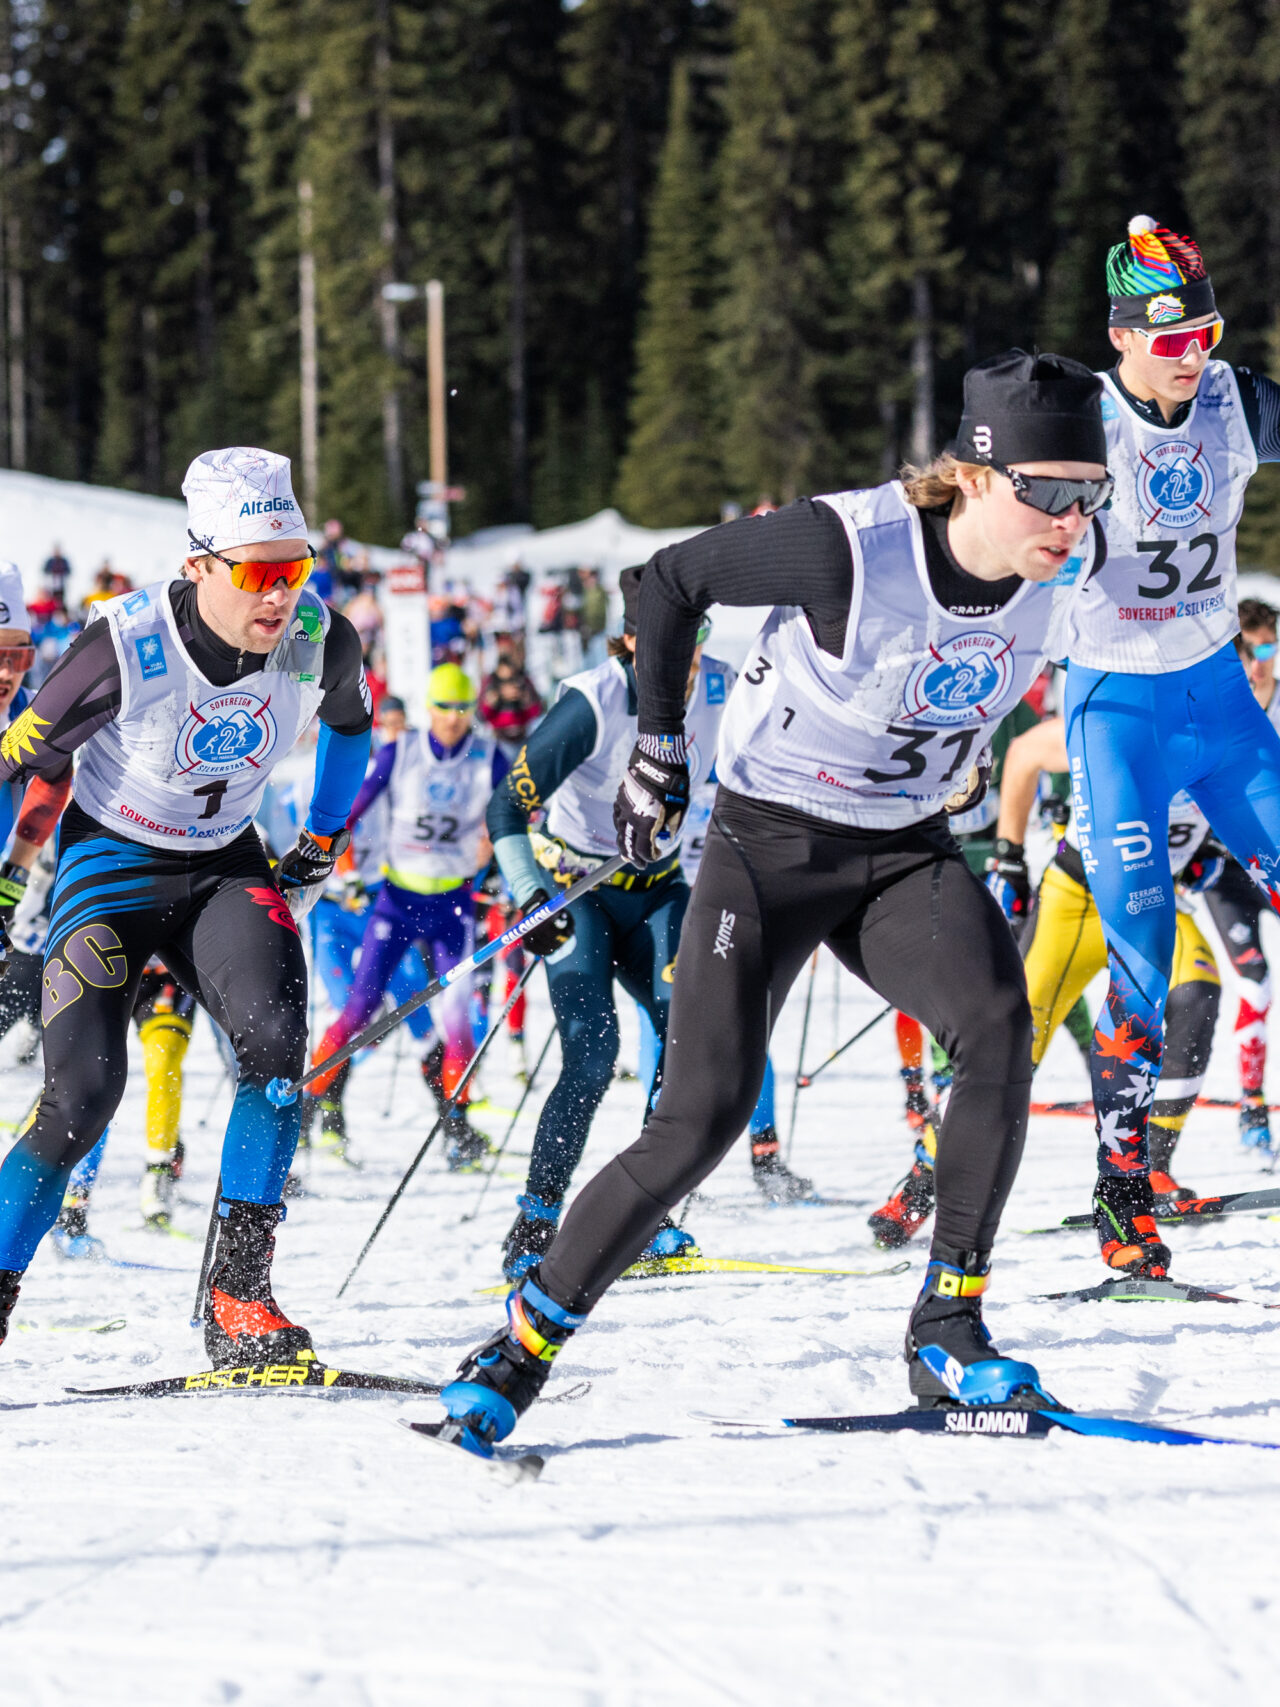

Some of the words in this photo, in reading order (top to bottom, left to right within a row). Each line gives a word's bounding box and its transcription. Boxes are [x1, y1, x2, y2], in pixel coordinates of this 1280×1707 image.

[239, 497, 295, 517] AltaGas
[1136, 532, 1222, 600] 32
[949, 605, 992, 615] CRAFT
[952, 636, 996, 652] SOVEREIGN
[209, 696, 252, 711] SOVEREIGN
[217, 726, 237, 755] 2
[197, 761, 246, 773] SILVERSTAR
[863, 725, 981, 785] 31
[193, 779, 229, 819] 1
[1128, 885, 1163, 900] FERRARO
[501, 906, 553, 946] SALOMON
[41, 923, 128, 1028] BC
[184, 1365, 309, 1390] FISCHER
[945, 1411, 1029, 1434] SALOMON
